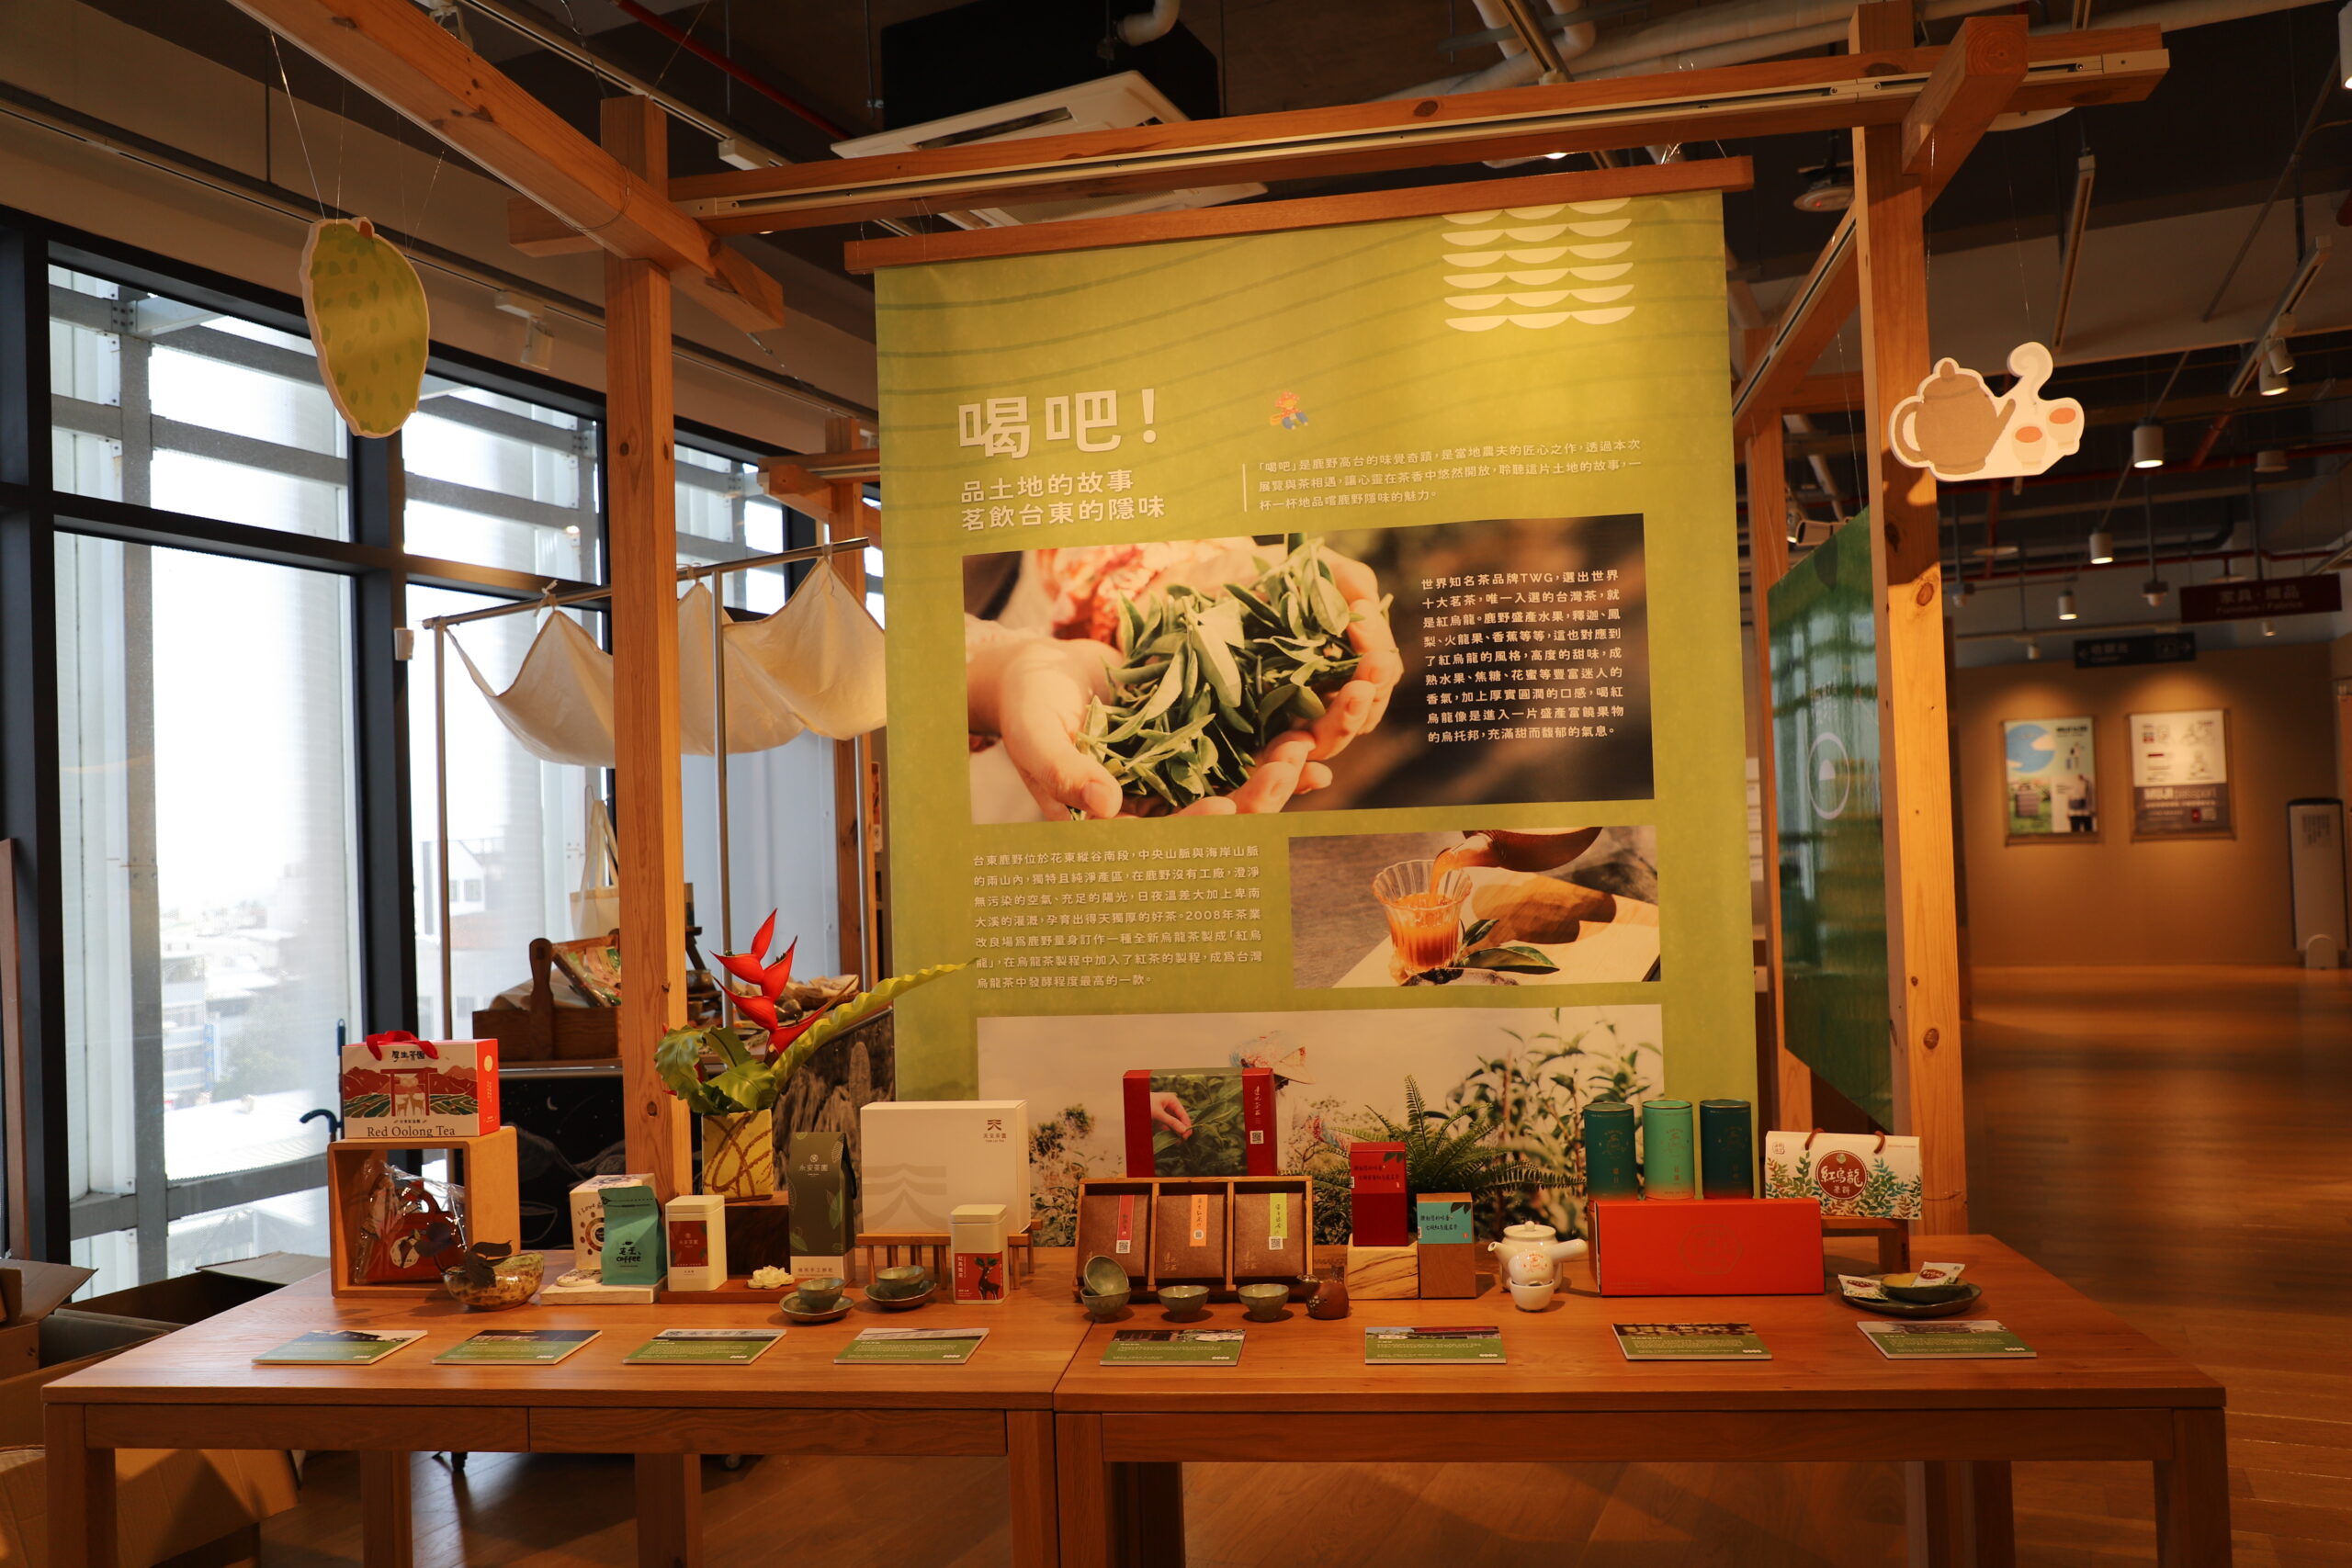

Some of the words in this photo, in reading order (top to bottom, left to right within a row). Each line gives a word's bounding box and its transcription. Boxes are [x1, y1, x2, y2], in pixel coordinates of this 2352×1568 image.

[961, 469, 1135, 503] 品土地的故事
[962, 495, 1166, 531] 茗飲台東的隱味
[368, 1126, 388, 1137] Red
[391, 1125, 433, 1138] Oolong
[435, 1125, 456, 1136] Tea
[1820, 1165, 1864, 1188] 紅烏龍
